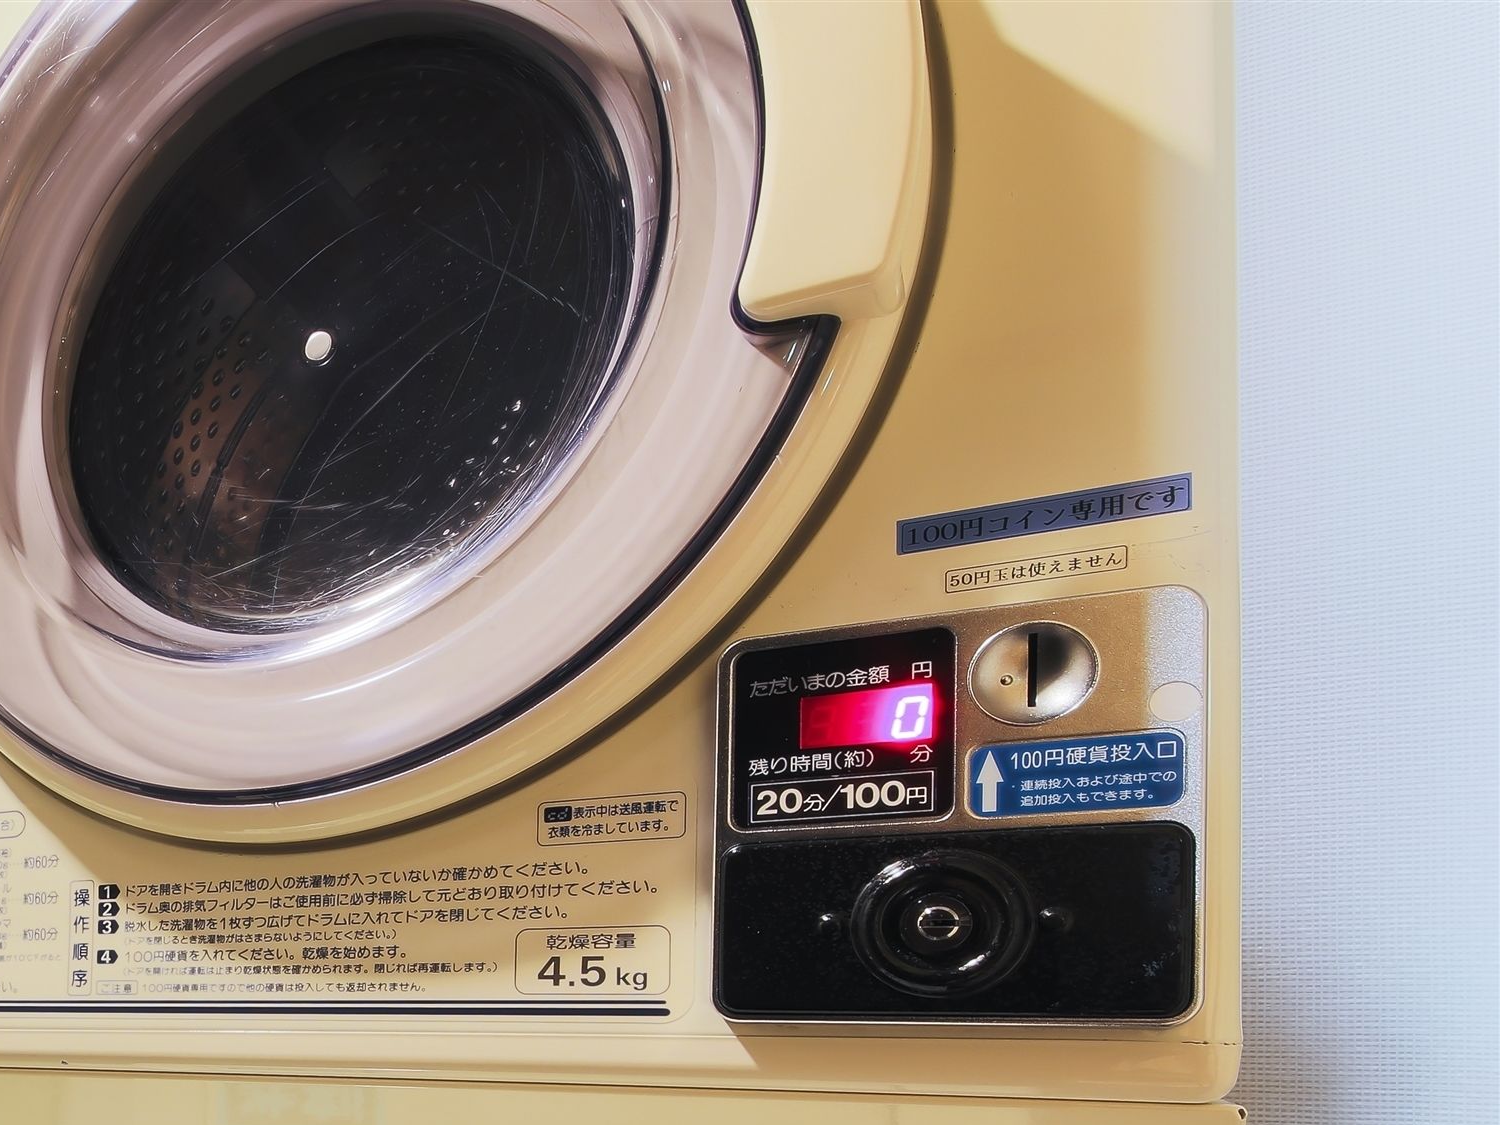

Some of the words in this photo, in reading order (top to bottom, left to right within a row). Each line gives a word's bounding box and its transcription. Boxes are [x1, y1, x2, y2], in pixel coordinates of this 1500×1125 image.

[905, 485, 1186, 549] 100円コイン専用です
[948, 550, 1124, 588] 50円玉は使えません
[749, 664, 890, 699] ただいまの金額
[910, 660, 934, 680] 円
[890, 694, 930, 740] 0
[909, 744, 934, 764] 分
[1010, 741, 1178, 770] 100円硬貨投入口
[755, 779, 929, 817] 20分/100円
[1019, 769, 1178, 793] 連続投入および途中での
[572, 799, 679, 819] 表示中は送風運転で
[1019, 790, 1156, 809] 追加投入もできます。
[547, 818, 671, 839] 衣類を冷ましています。
[124, 861, 589, 898] ドアを開きドラム内に他の人の洗濯物が入っていないか確かめてください。
[124, 879, 659, 915] ドラム奥の排気フィルターはご使用前に必ず掃除して元どおり取り付けてください。
[124, 904, 569, 932] 脱水した洗濯物を1枚ずつ広げてドラムに入れてドアを閉じてください。
[71, 888, 91, 988] 操作順序
[545, 932, 638, 951] 乾燥容量
[536, 954, 607, 988] 4.5
[615, 966, 649, 991] kg
